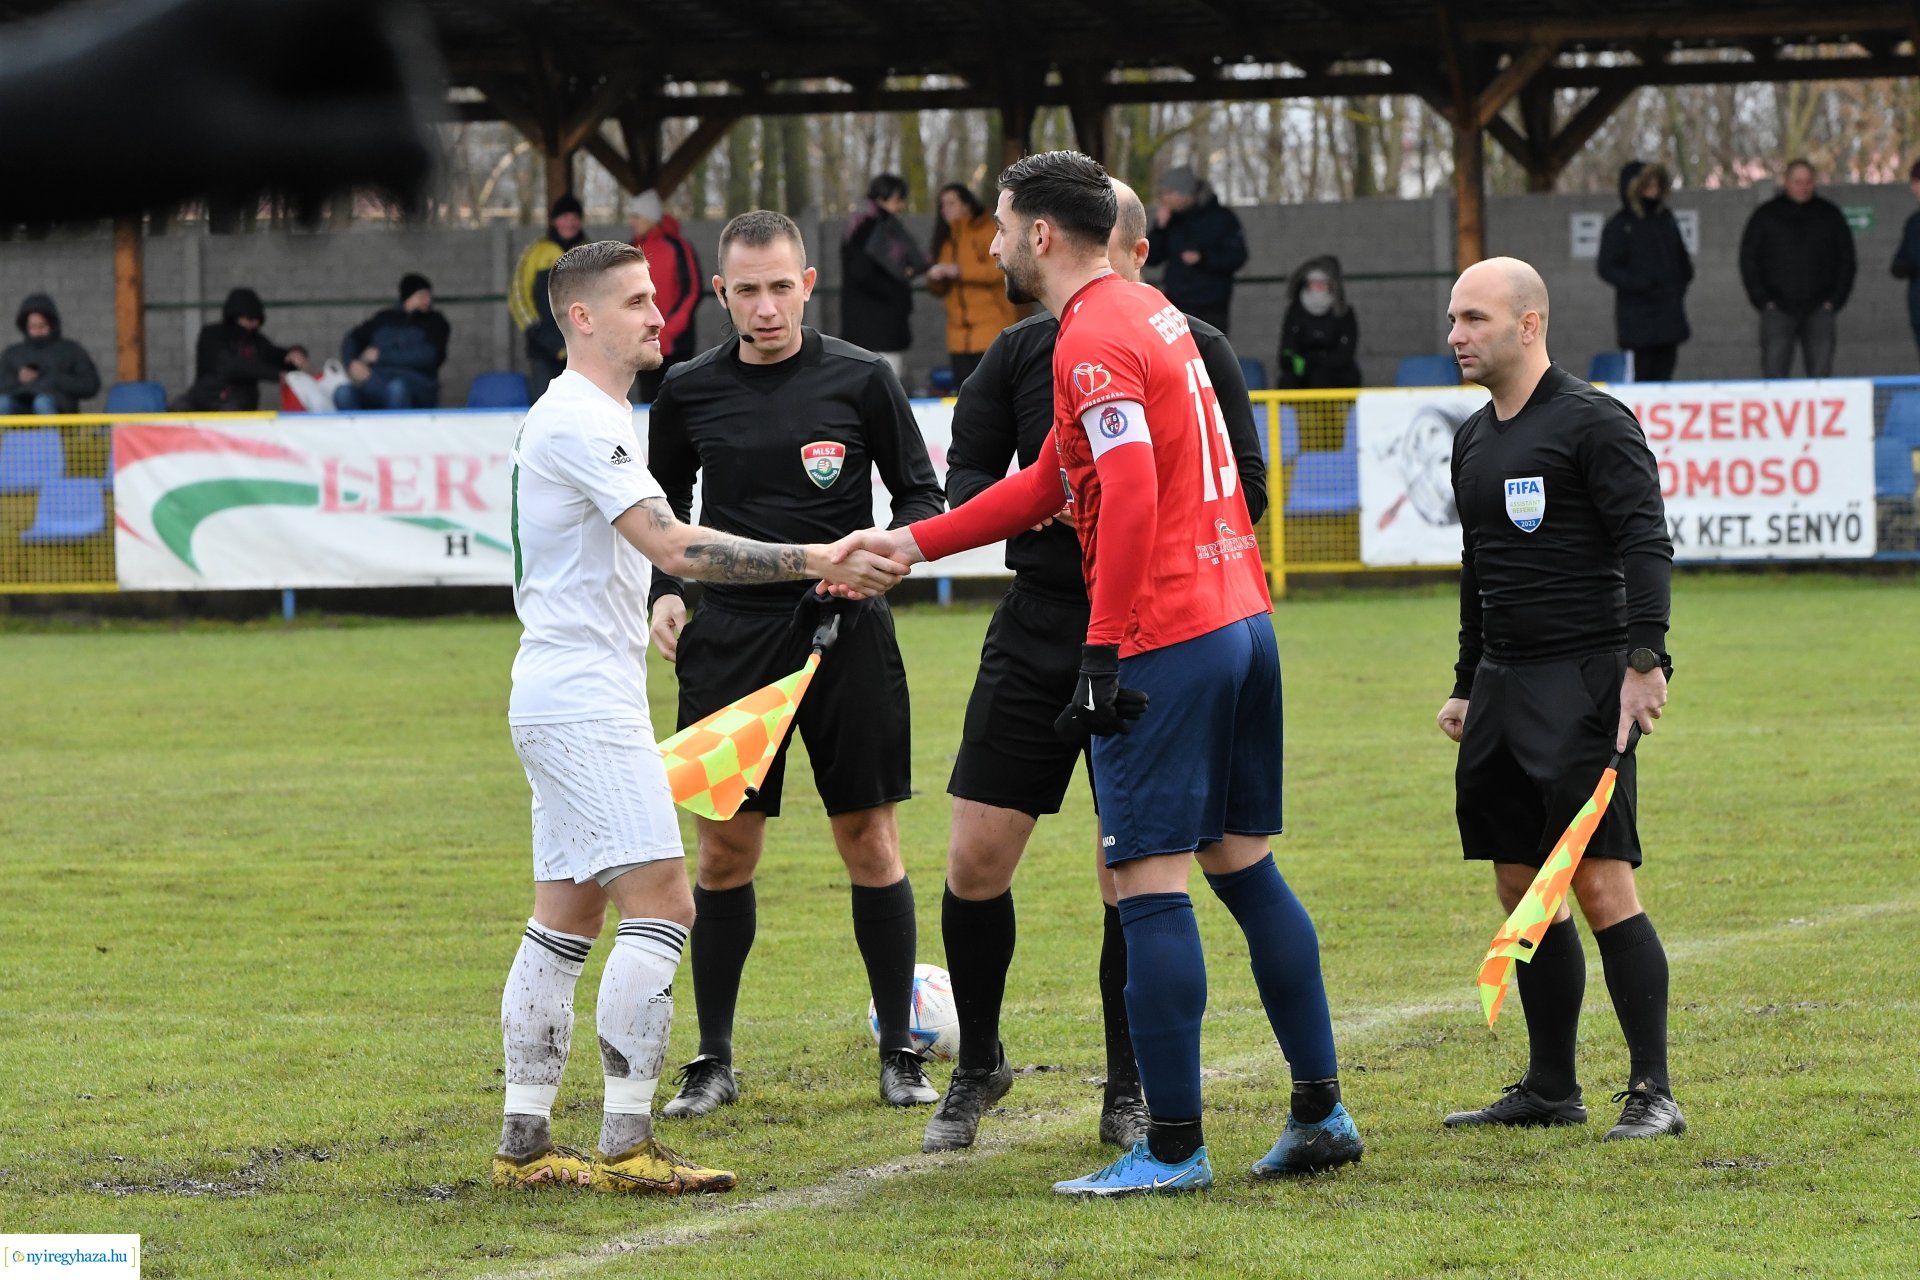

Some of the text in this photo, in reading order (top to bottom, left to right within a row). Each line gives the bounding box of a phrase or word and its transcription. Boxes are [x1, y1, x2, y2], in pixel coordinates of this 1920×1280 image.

[1184, 358, 1238, 502] 13
[812, 447, 836, 456] MLSZ
[1508, 481, 1539, 495] FIFA
[1520, 520, 1537, 528] 2022
[1697, 513, 1756, 547] KFT.
[1766, 502, 1863, 545] SÉNYŐ
